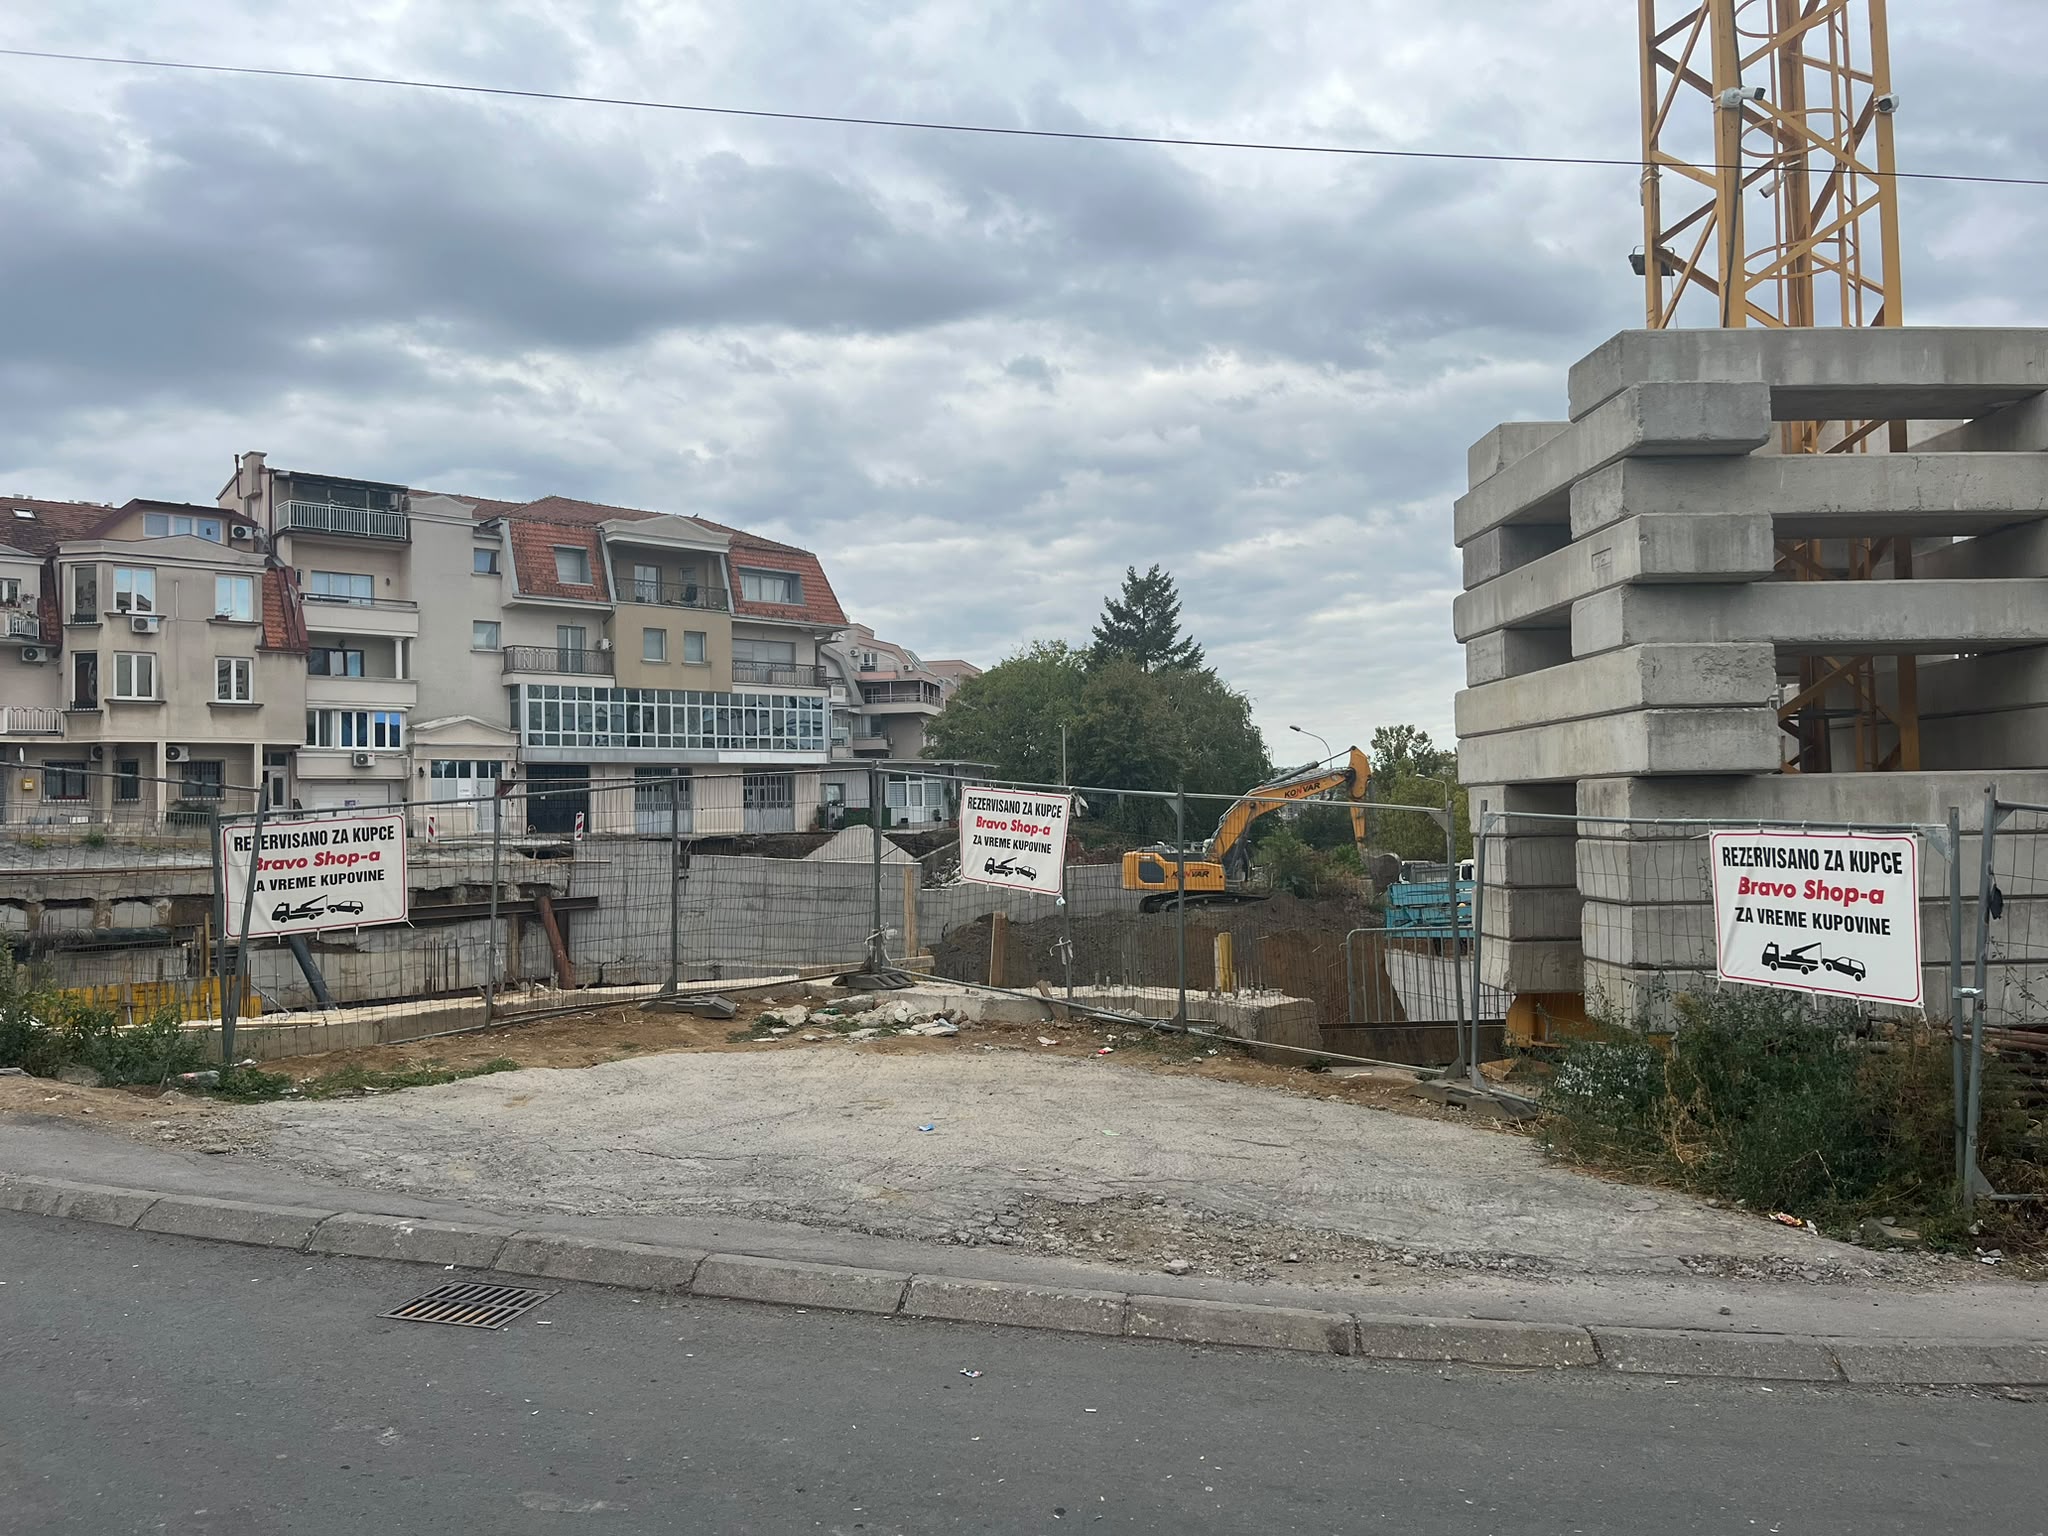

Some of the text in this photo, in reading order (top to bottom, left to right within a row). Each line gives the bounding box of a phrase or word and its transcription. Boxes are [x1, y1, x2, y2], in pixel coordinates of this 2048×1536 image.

[1285, 783, 1320, 798] KONVAR
[967, 796, 1062, 819] REZERVISANO ZA KUPCE
[976, 815, 1051, 837] Bravo Shop-a
[234, 825, 395, 852] REERVISANO ZA KUPCE
[973, 834, 1052, 854] ZA VREME KUPOVINE
[313, 850, 381, 868] Shop-a
[1722, 846, 1903, 874] REZERVISANO ZA KUPCE
[269, 875, 316, 891] VREME
[320, 869, 385, 886] KUPOVINE
[1171, 870, 1209, 878] KNVAR
[1737, 876, 1885, 907] Bravo Shop-a
[1734, 907, 1891, 936] ZA VREME KUPOVINE
